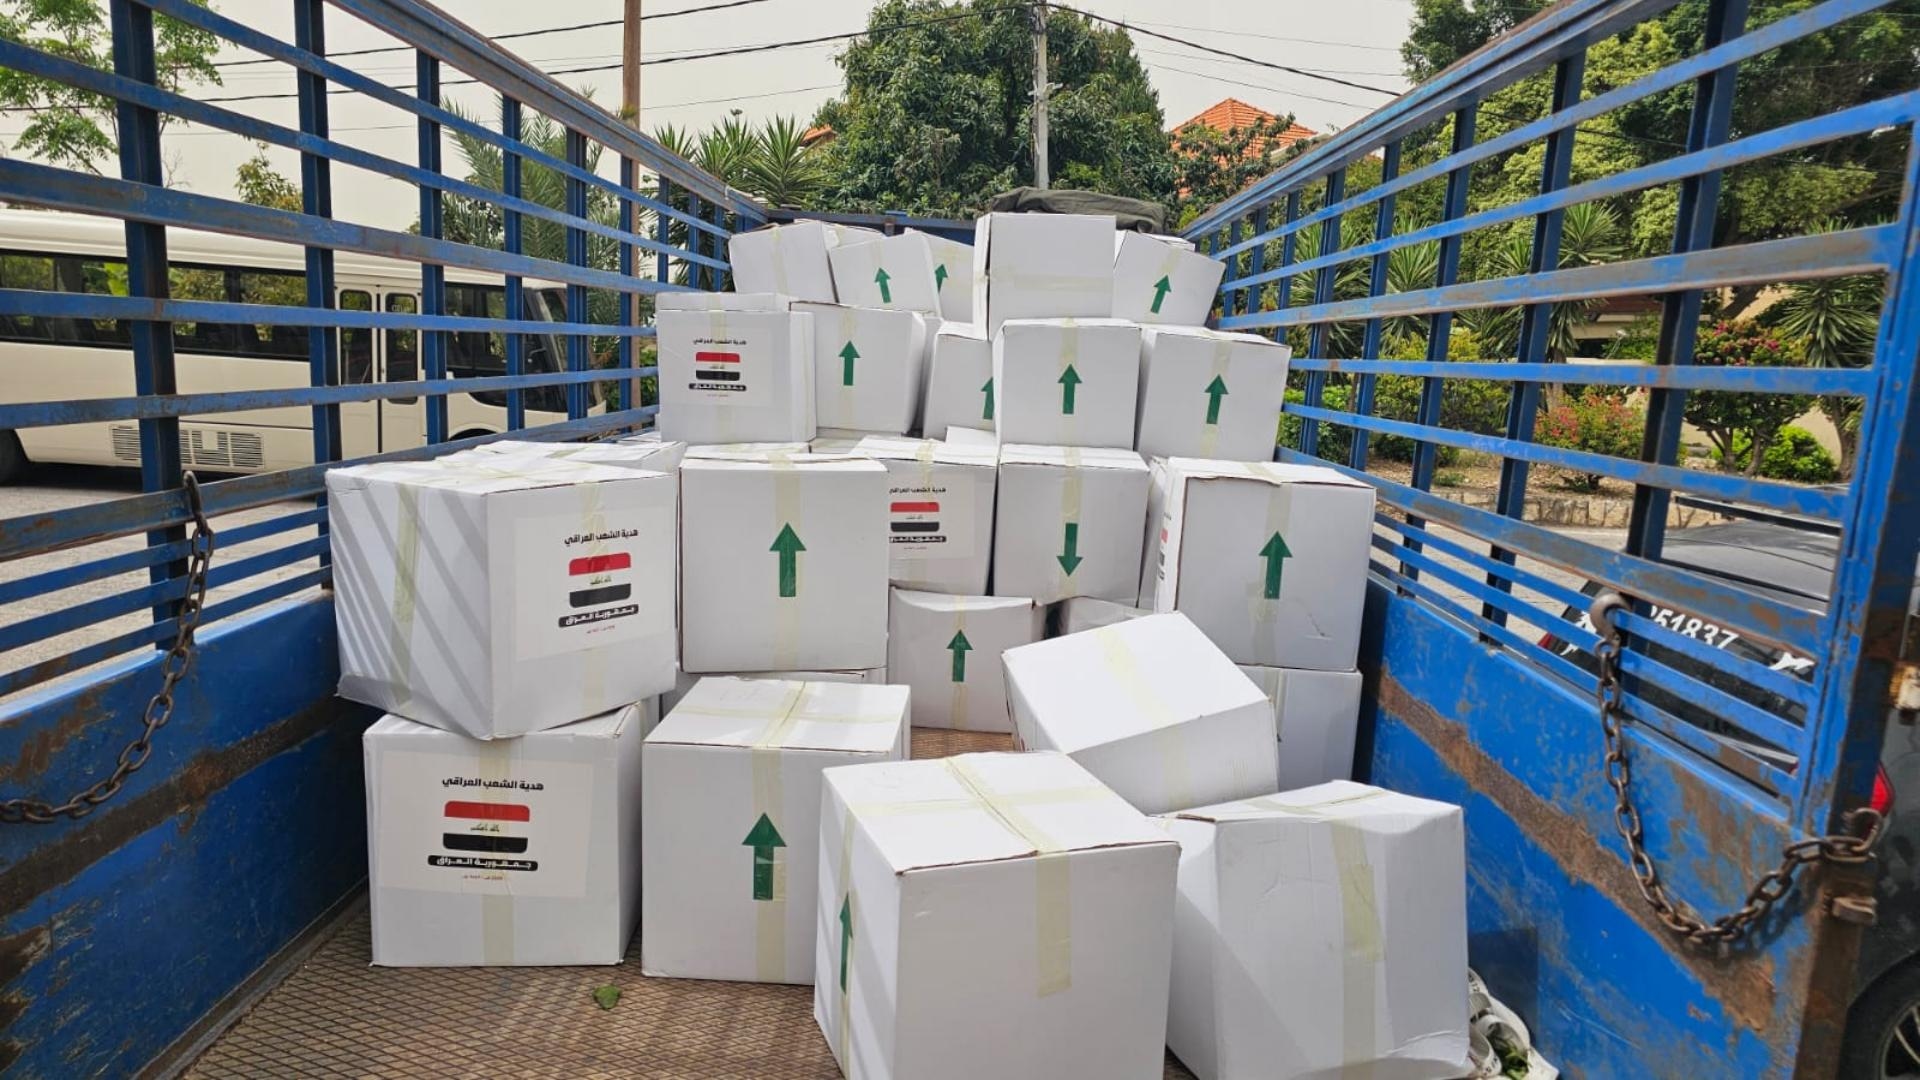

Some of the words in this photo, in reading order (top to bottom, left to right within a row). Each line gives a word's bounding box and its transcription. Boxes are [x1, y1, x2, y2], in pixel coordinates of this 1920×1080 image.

[596, 530, 620, 543] الشعب
[622, 528, 638, 538] هدية
[564, 533, 595, 547] العراقي
[565, 613, 594, 626] العراق
[594, 606, 635, 621] جمهورية
[1651, 604, 1739, 650] 51837
[442, 776, 481, 788] العراقي
[483, 778, 517, 790] الشعب
[519, 780, 544, 792] هدية
[436, 856, 473, 867] العراق
[474, 857, 532, 870] جمهورية
